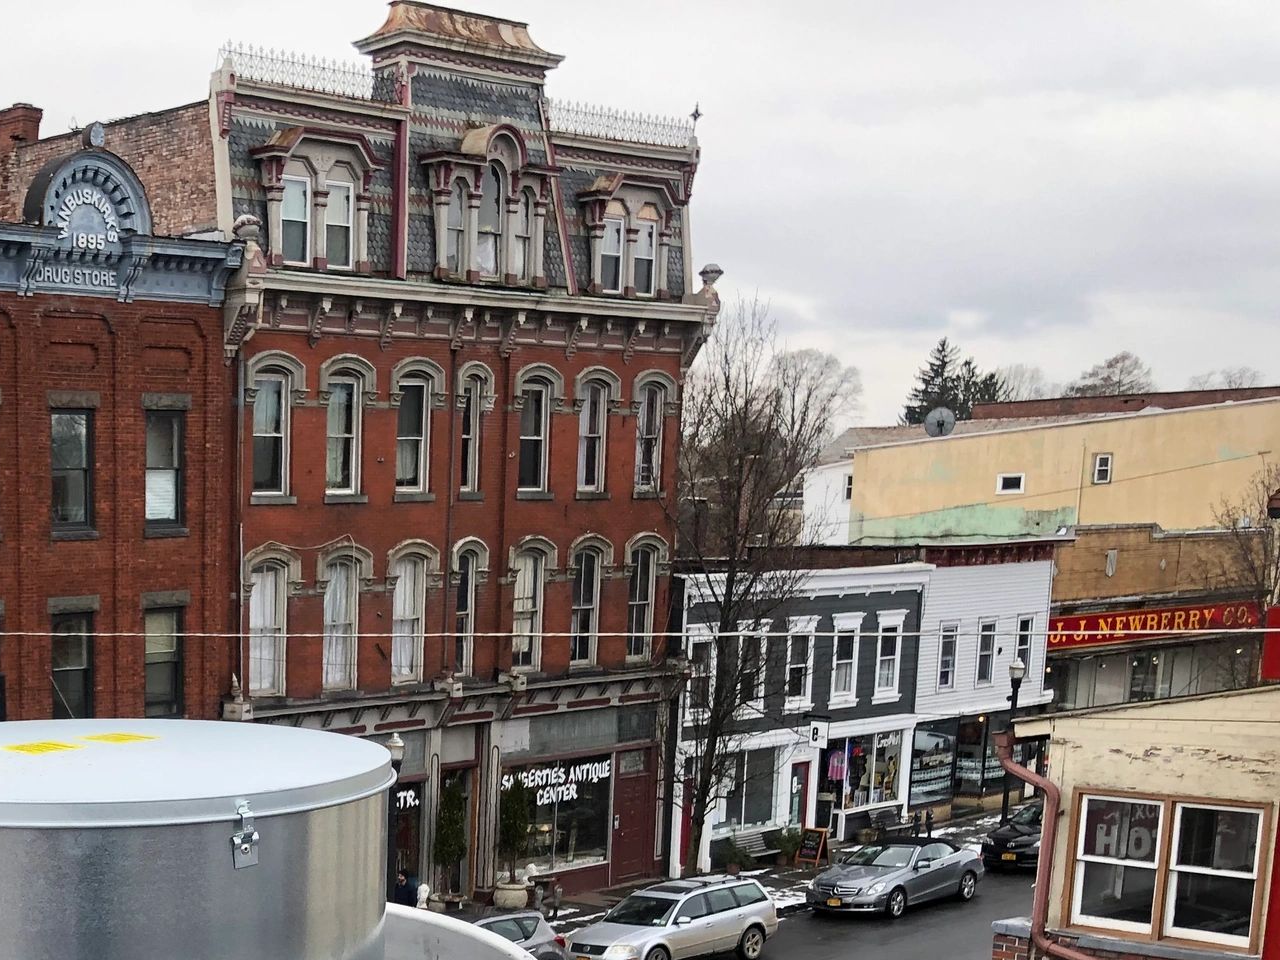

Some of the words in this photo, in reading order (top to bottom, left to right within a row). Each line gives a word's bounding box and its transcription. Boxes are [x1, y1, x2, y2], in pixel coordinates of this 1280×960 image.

[72, 234, 105, 250] 1895
[36, 268, 70, 283] DRUG
[74, 270, 118, 286] STORE
[1097, 608, 1216, 638] NEWBERRY
[1223, 606, 1252, 626] CO.
[568, 759, 610, 783] ANTIQUE
[396, 790, 420, 810] TR.
[536, 784, 578, 806] CENTER
